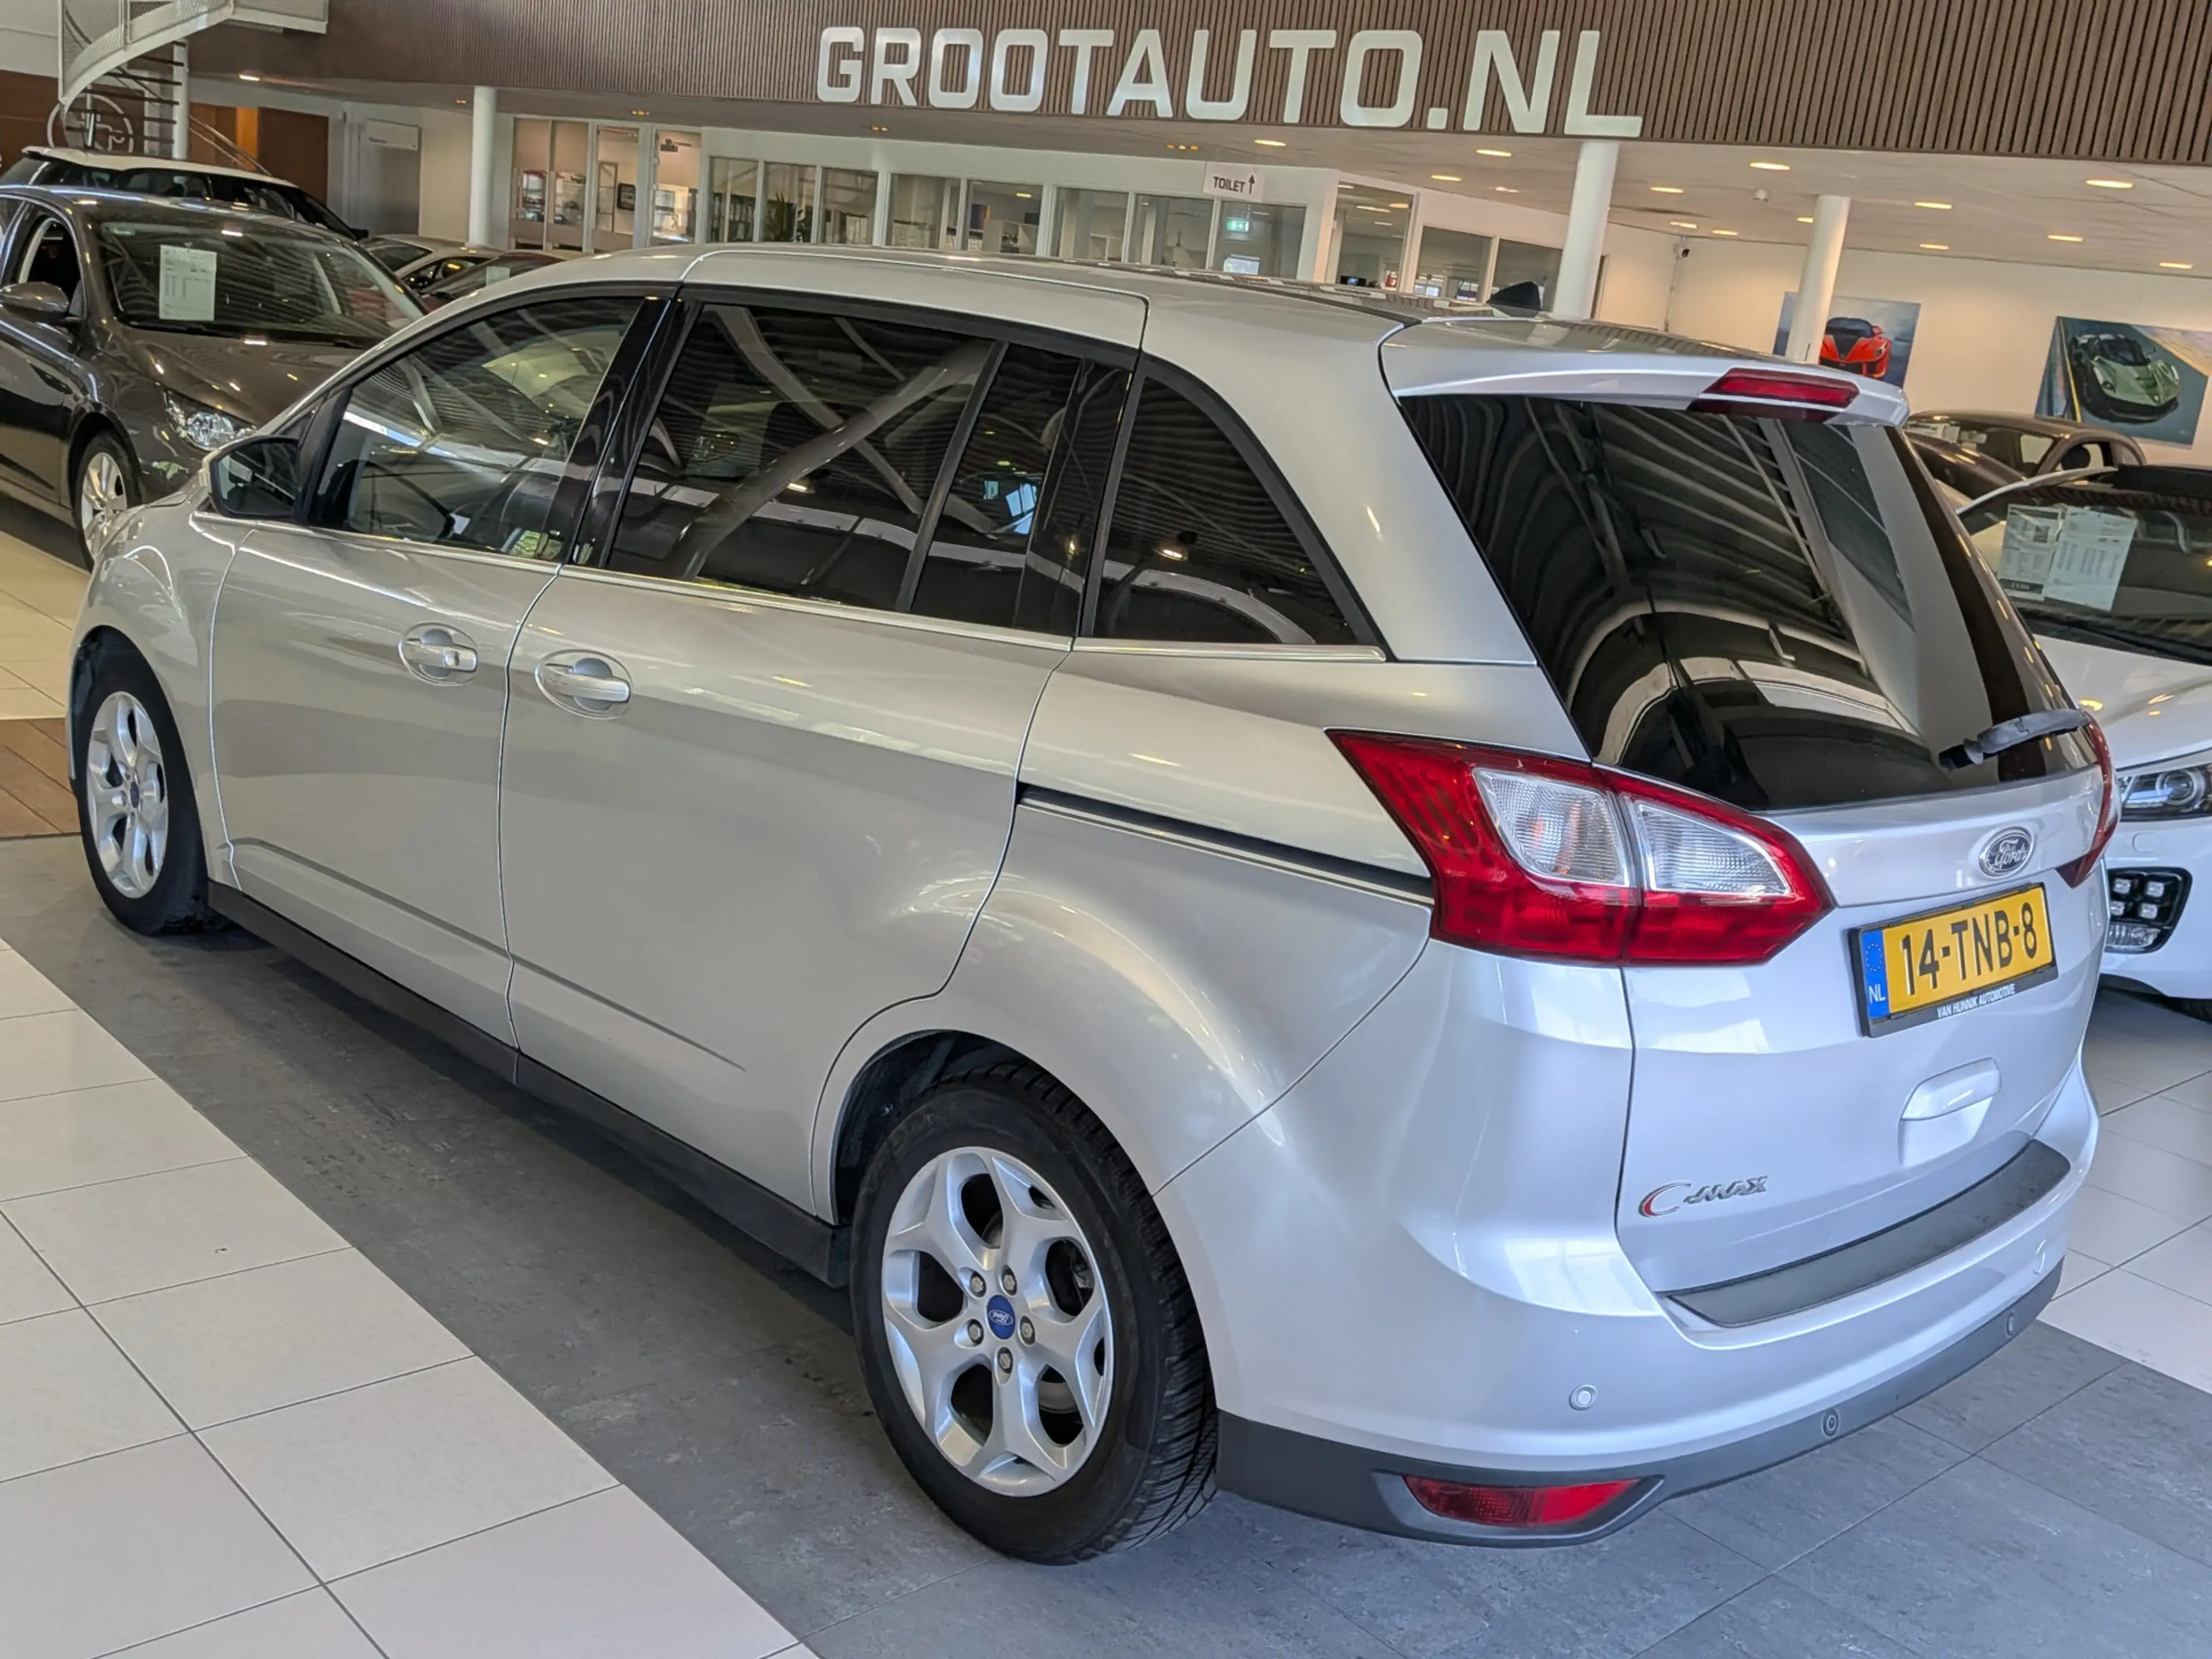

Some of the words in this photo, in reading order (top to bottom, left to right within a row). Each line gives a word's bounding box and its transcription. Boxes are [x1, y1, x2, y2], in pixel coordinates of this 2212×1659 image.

[817, 26, 1643, 138] GROOTAUTO.NL
[1213, 176, 1246, 193] TOILET
[1985, 839, 2028, 869] Ford
[1901, 902, 2037, 995] 14-TNB-8
[1869, 983, 1886, 1004] NL
[1937, 1004, 1952, 1018] VAN
[1978, 983, 2015, 1005] AUTOMOTIVE
